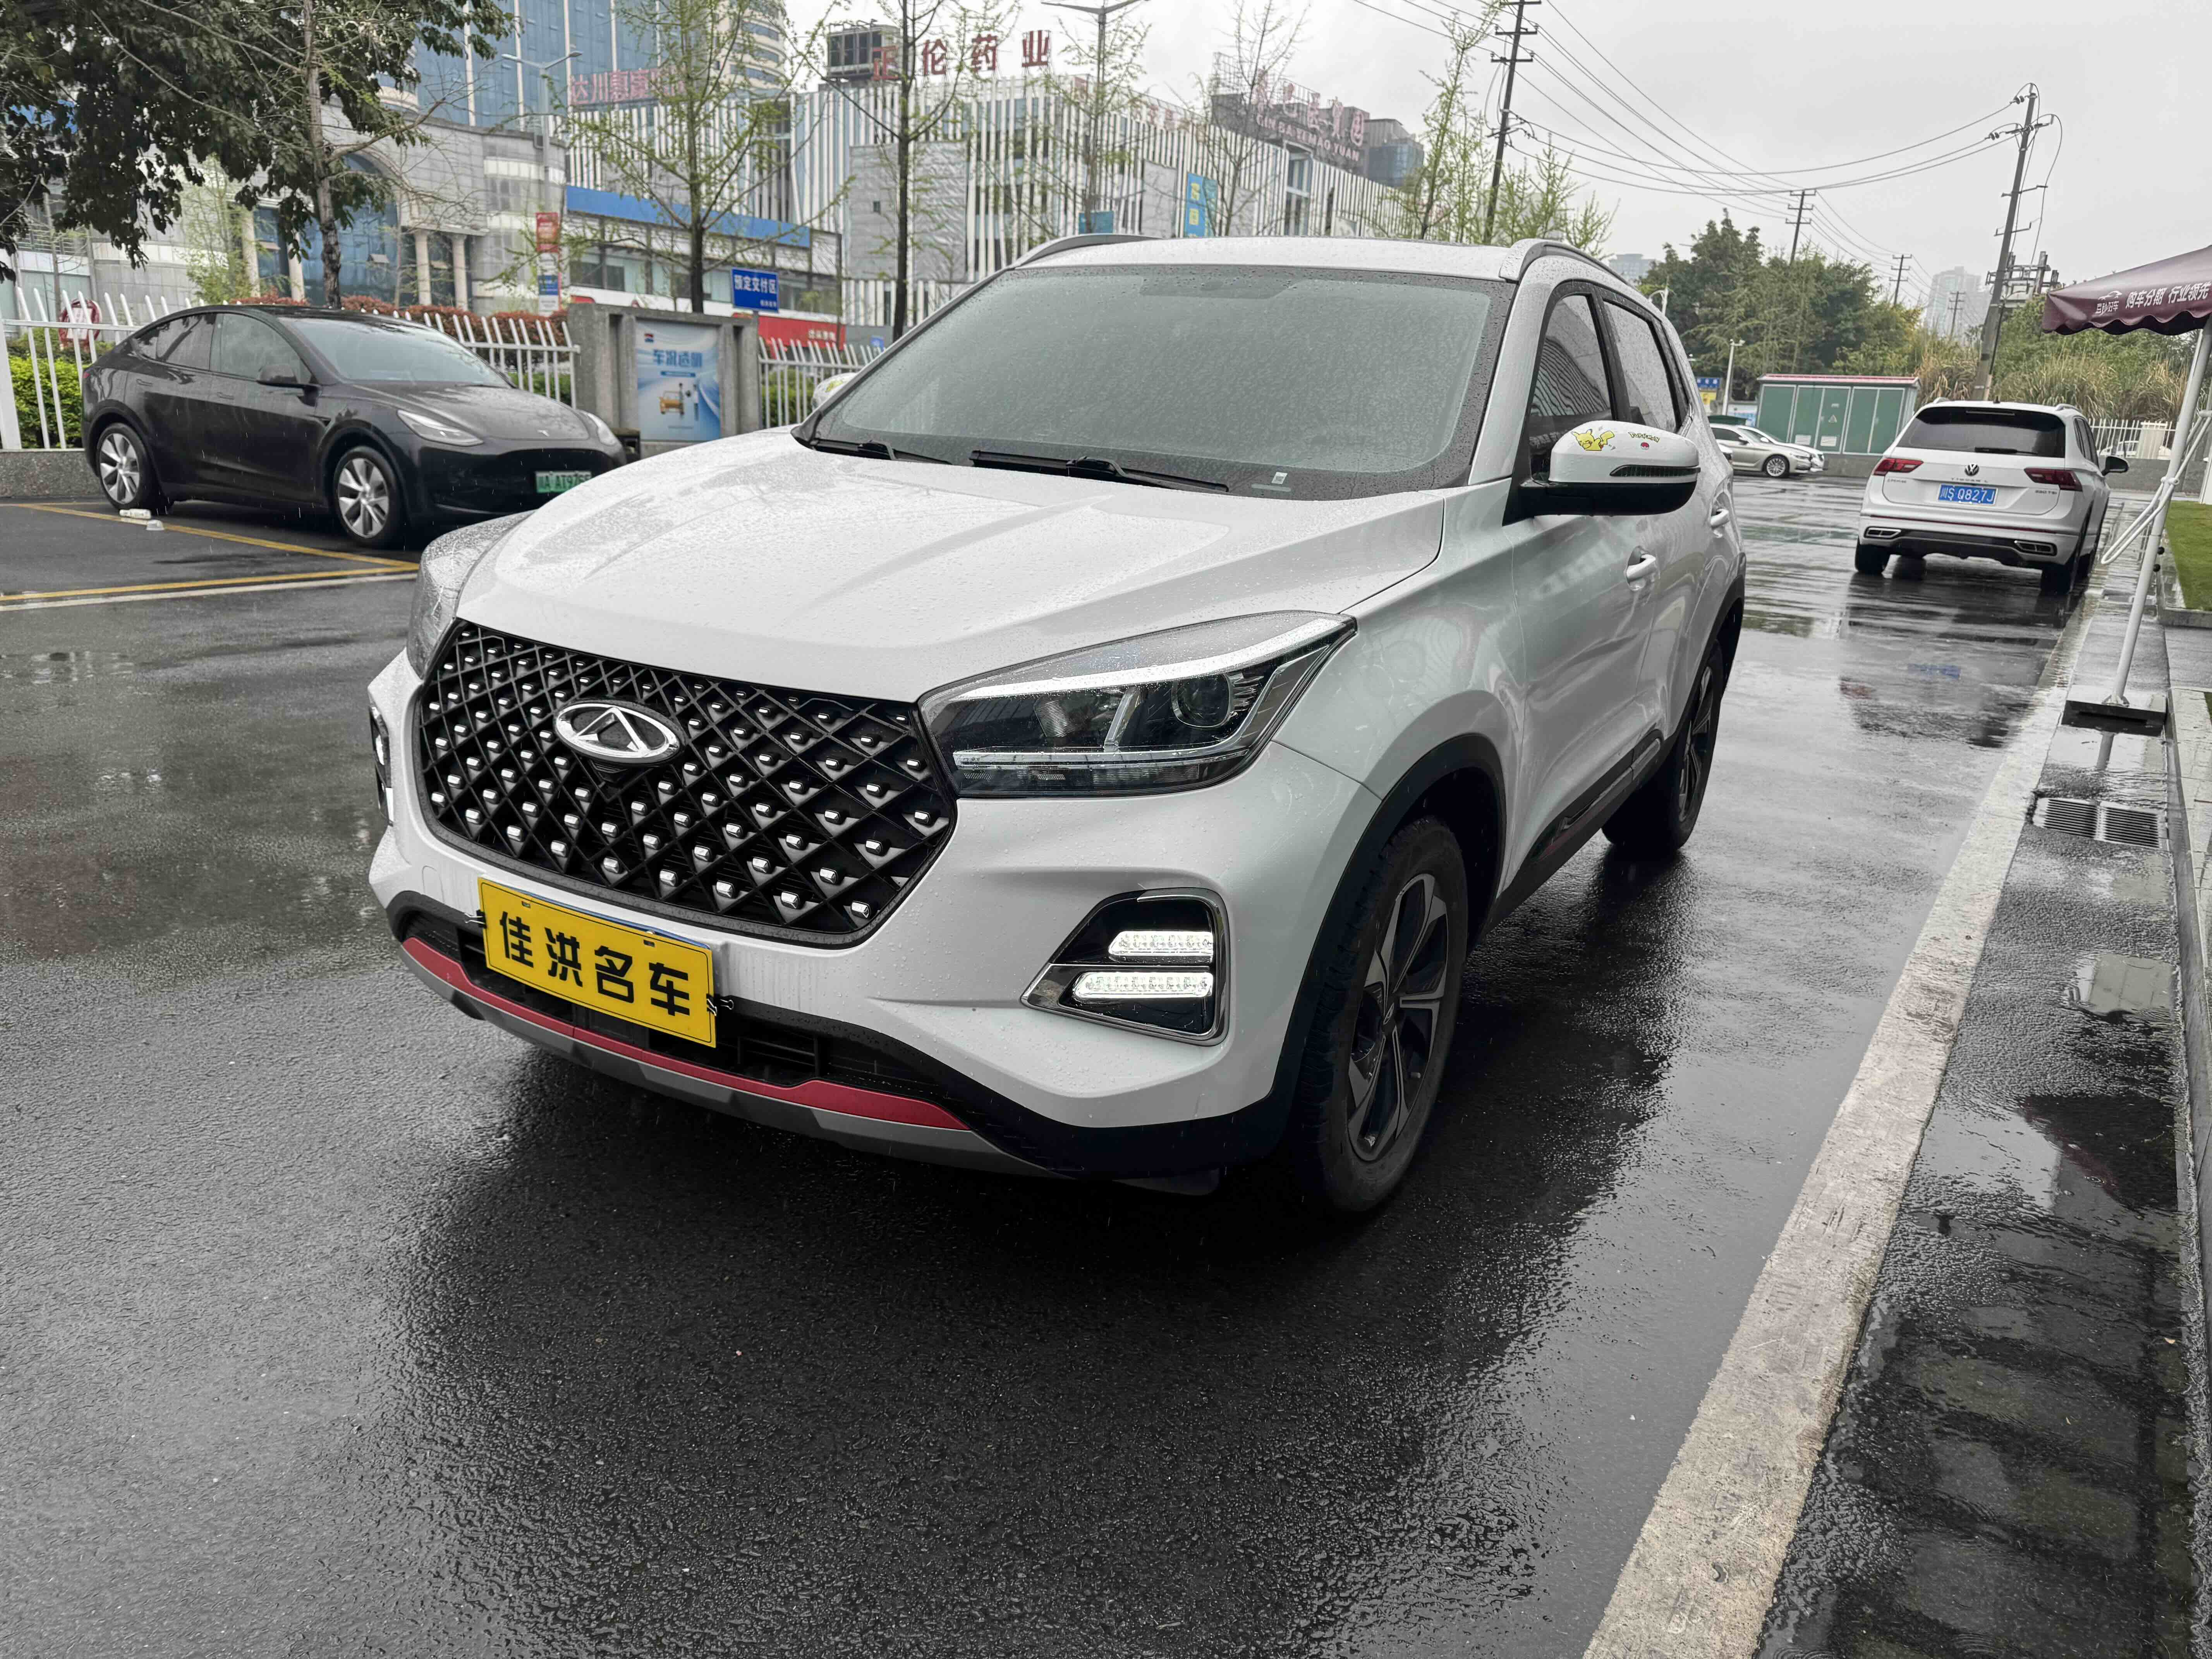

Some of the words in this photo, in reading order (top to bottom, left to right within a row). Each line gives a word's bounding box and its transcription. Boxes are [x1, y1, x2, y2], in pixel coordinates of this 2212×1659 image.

[2126, 287, 2167, 309] 购车分期
[2169, 282, 2211, 304] 行业领先
[500, 911, 690, 1016] 佳洪名车
